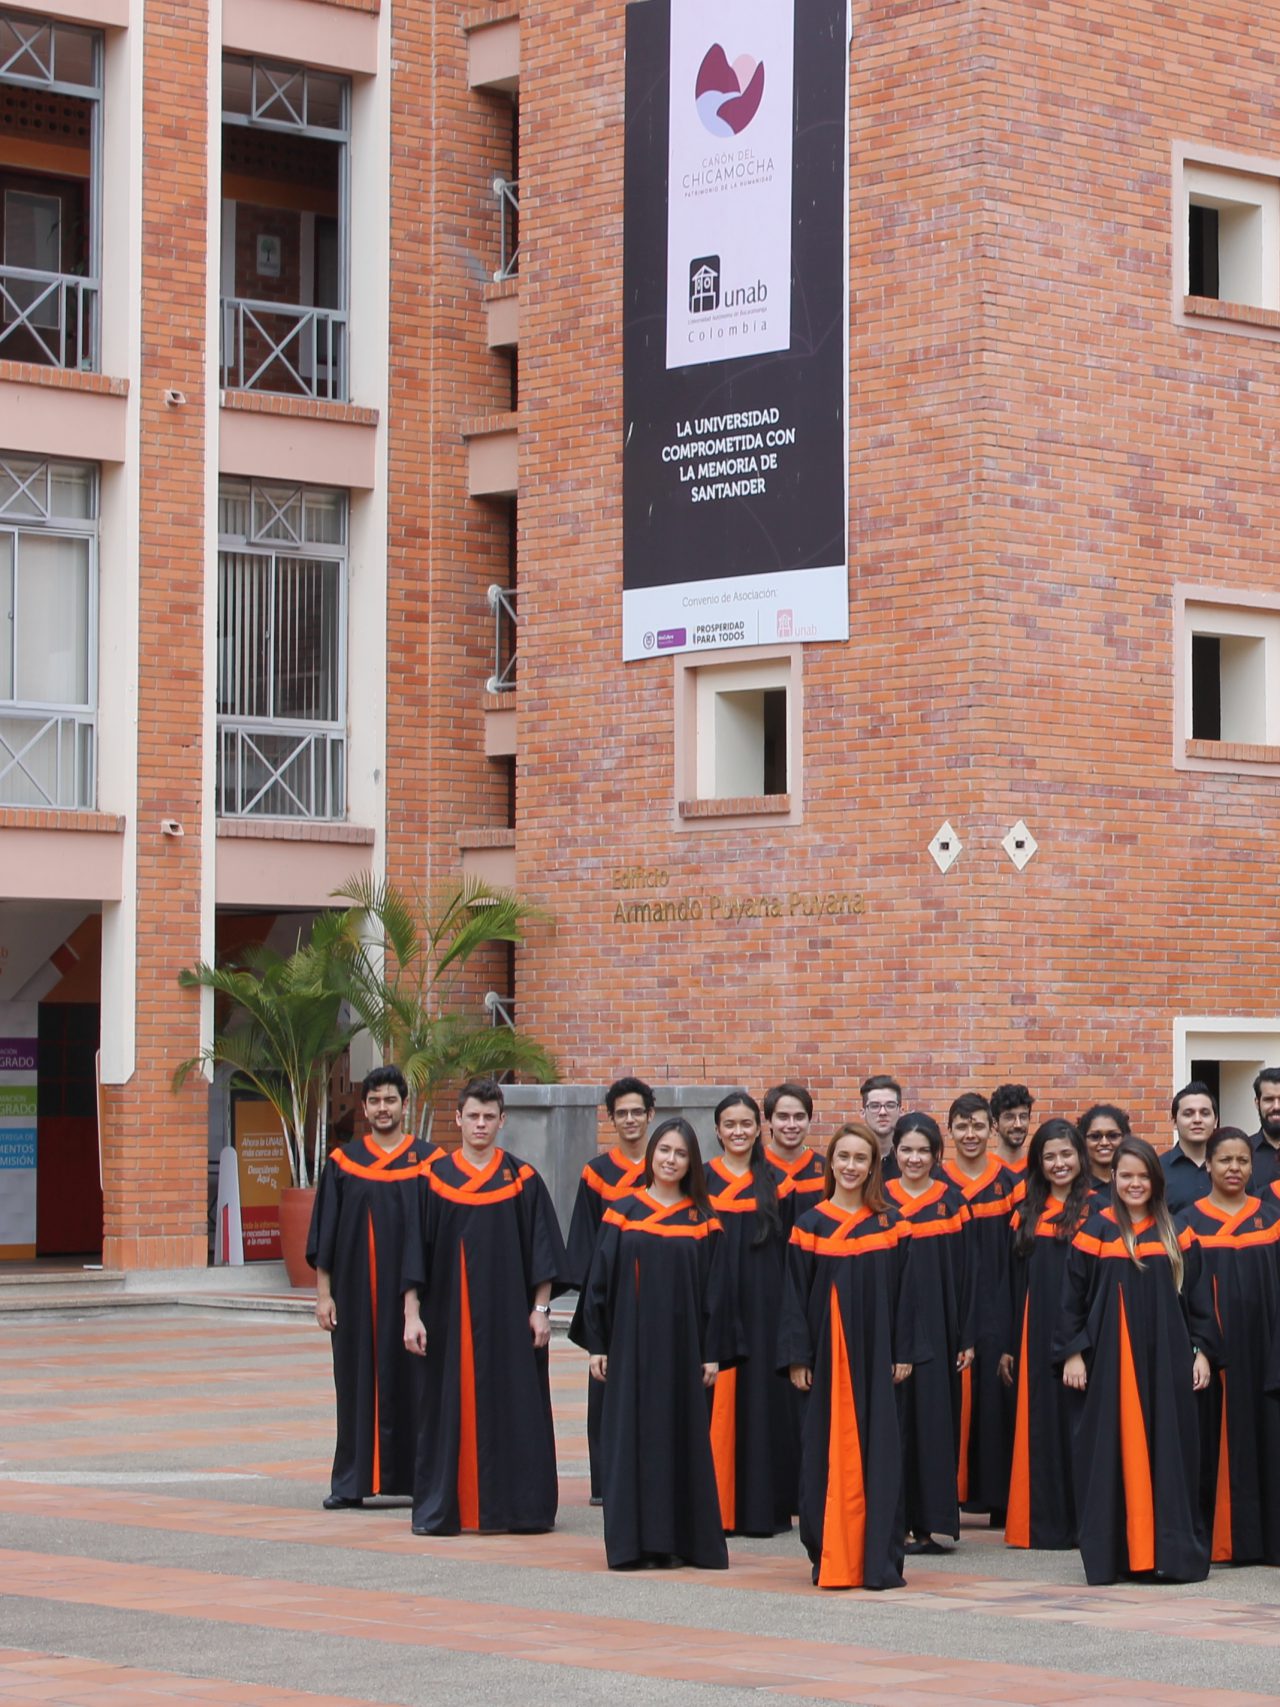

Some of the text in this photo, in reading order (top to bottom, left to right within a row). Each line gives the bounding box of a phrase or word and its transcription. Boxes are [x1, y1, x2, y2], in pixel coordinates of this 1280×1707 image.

[702, 149, 755, 168] CAÑÓN DEL
[682, 157, 775, 189] CHICAMOCHA
[684, 186, 718, 197] PATRIMONIO
[740, 175, 773, 187] HUMANIDAD
[725, 279, 767, 308] unab
[688, 320, 767, 343] Colombia
[676, 408, 780, 438] LA UNIVERSIDAD
[662, 428, 796, 462] COMPROMETIDA CON
[679, 453, 778, 482] LA MEMORIA DE
[691, 478, 766, 502] SANTANDER
[682, 596, 720, 607] Convenio
[721, 593, 731, 603] de
[697, 621, 745, 634] PROSPERIDAD
[697, 631, 745, 645] PARA TODOS
[794, 624, 817, 637] unab
[612, 865, 669, 889] Edificio
[612, 891, 865, 924] Armando Puyana Puyana
